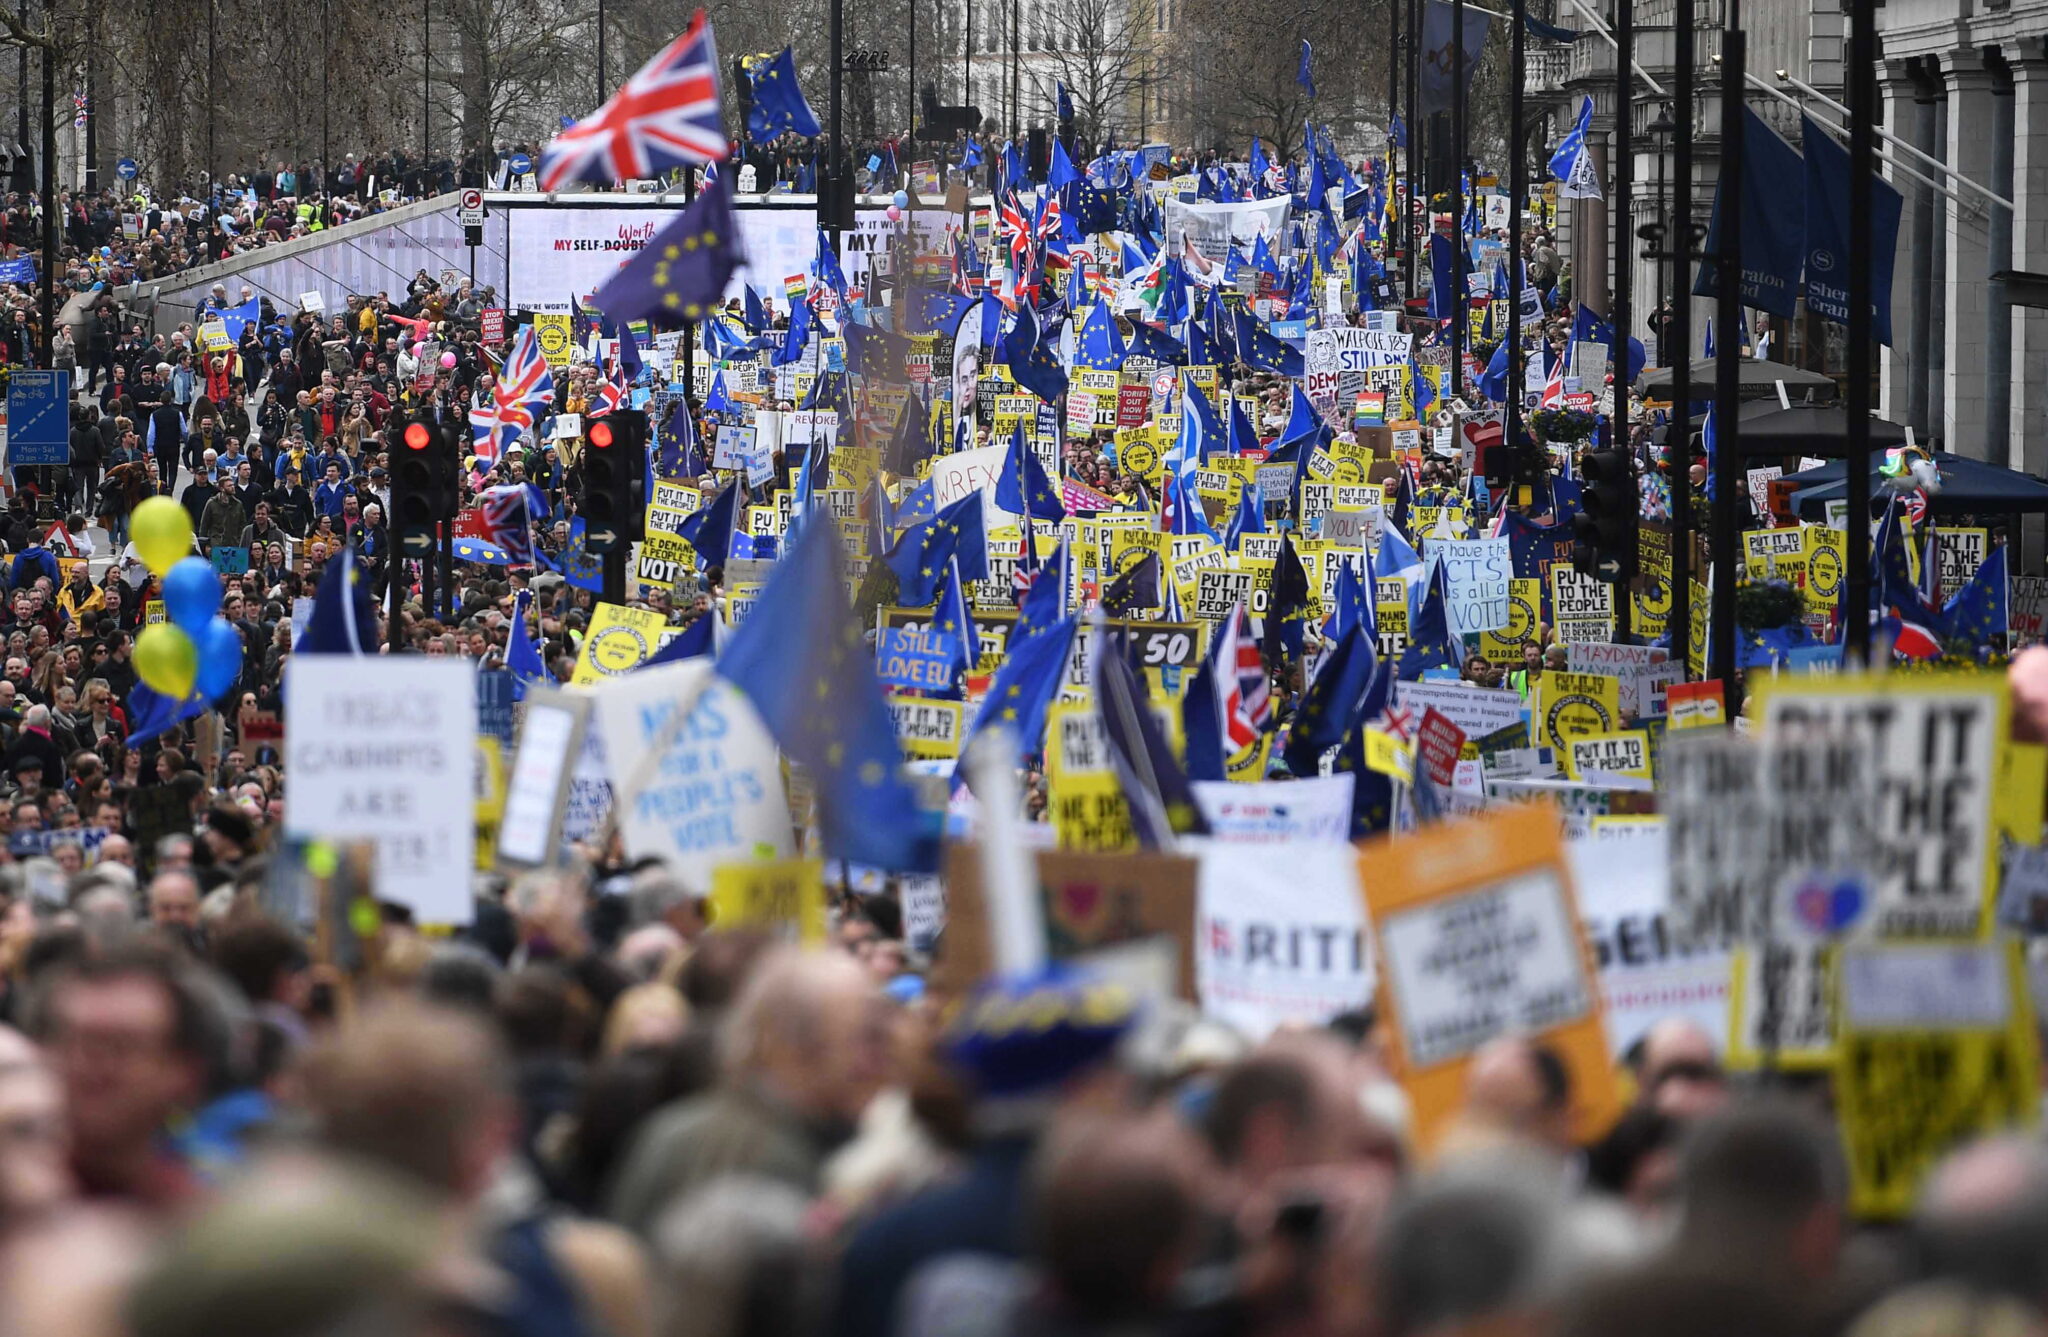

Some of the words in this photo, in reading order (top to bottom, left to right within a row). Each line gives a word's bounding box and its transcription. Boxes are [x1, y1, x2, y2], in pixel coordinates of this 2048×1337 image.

[618, 222, 656, 241] Worth
[555, 240, 572, 250] MY
[848, 234, 877, 251] MY
[1808, 297, 1848, 319] Gran
[1279, 327, 1298, 338] NHS
[1126, 358, 1156, 366] PEOPLE
[1083, 373, 1097, 382] PUT
[1372, 371, 1390, 379] PUT
[1002, 383, 1011, 391] OFF
[1373, 381, 1383, 389] TO
[1387, 380, 1401, 388] THE
[999, 398, 1013, 407] PUT
[1023, 399, 1033, 407] TO
[795, 415, 837, 425] REVOKE
[1461, 411, 1486, 424] BERCOW
[1338, 442, 1351, 452] PUT
[1207, 472, 1214, 480] IT
[1258, 469, 1290, 478] REVOKE
[1202, 481, 1226, 490] PEOPLE
[1305, 486, 1329, 497] PUT
[658, 488, 673, 499] PUT
[675, 491, 684, 500] IT
[686, 493, 696, 504] TO
[1338, 488, 1355, 497] PUT
[1358, 489, 1366, 497] IT
[1370, 490, 1380, 498] TO
[657, 497, 671, 505] THE
[673, 499, 695, 511] PEOPLE
[1338, 496, 1350, 504] THE
[1352, 497, 1379, 505] PEOPLE
[651, 510, 672, 522] PUT
[1124, 530, 1138, 539] PUT
[1153, 532, 1162, 540] TO
[1750, 536, 1768, 546] PUT
[1773, 535, 1781, 544] IT
[1787, 533, 1798, 543] TO
[643, 537, 656, 547] WE
[658, 539, 694, 554] DEMAND
[988, 542, 1006, 552] PUT
[1010, 542, 1018, 552] IT
[1245, 539, 1266, 549] PUT
[1269, 540, 1277, 548] IT
[1966, 535, 1980, 549] IT
[1188, 542, 1200, 555] IT
[1450, 544, 1482, 557] have
[1489, 543, 1508, 557] the
[1773, 544, 1800, 553] EOPLE
[649, 548, 694, 566] PEOPLE'S
[1175, 562, 1194, 576] PUT
[1196, 557, 1204, 568] IT
[1210, 552, 1220, 562] TO
[1446, 558, 1503, 582] CTS
[1750, 565, 1762, 576] WE
[1775, 561, 1806, 573] EMAND
[1202, 574, 1231, 588] PUT
[1236, 576, 1250, 589] IT
[1558, 571, 1584, 584] PUT
[1201, 588, 1216, 600] TO
[1468, 582, 1489, 598] all
[1558, 586, 1574, 599] TO
[1580, 584, 1607, 597] THE
[1559, 599, 1608, 611] PEOPLE
[148, 614, 163, 624] VOTE
[881, 632, 887, 648] I
[893, 631, 947, 656] STILL
[1144, 633, 1191, 664] 50
[1574, 644, 1648, 663] MAYDAY!
[877, 656, 925, 682] LOVE
[1808, 660, 1836, 675] NH
[1555, 674, 1573, 685] PUT
[1579, 675, 1587, 685] IT
[1593, 677, 1605, 686] TO
[1411, 688, 1468, 699] incompetence
[1555, 684, 1569, 692] THE
[1575, 684, 1604, 695] PEOPLE
[1440, 705, 1465, 714] peace
[1574, 743, 1599, 757] PUT
[1605, 741, 1618, 756] IT
[1624, 740, 1640, 755] TO
[1576, 760, 1595, 772] THE
[1600, 757, 1642, 770] PEOPLE
